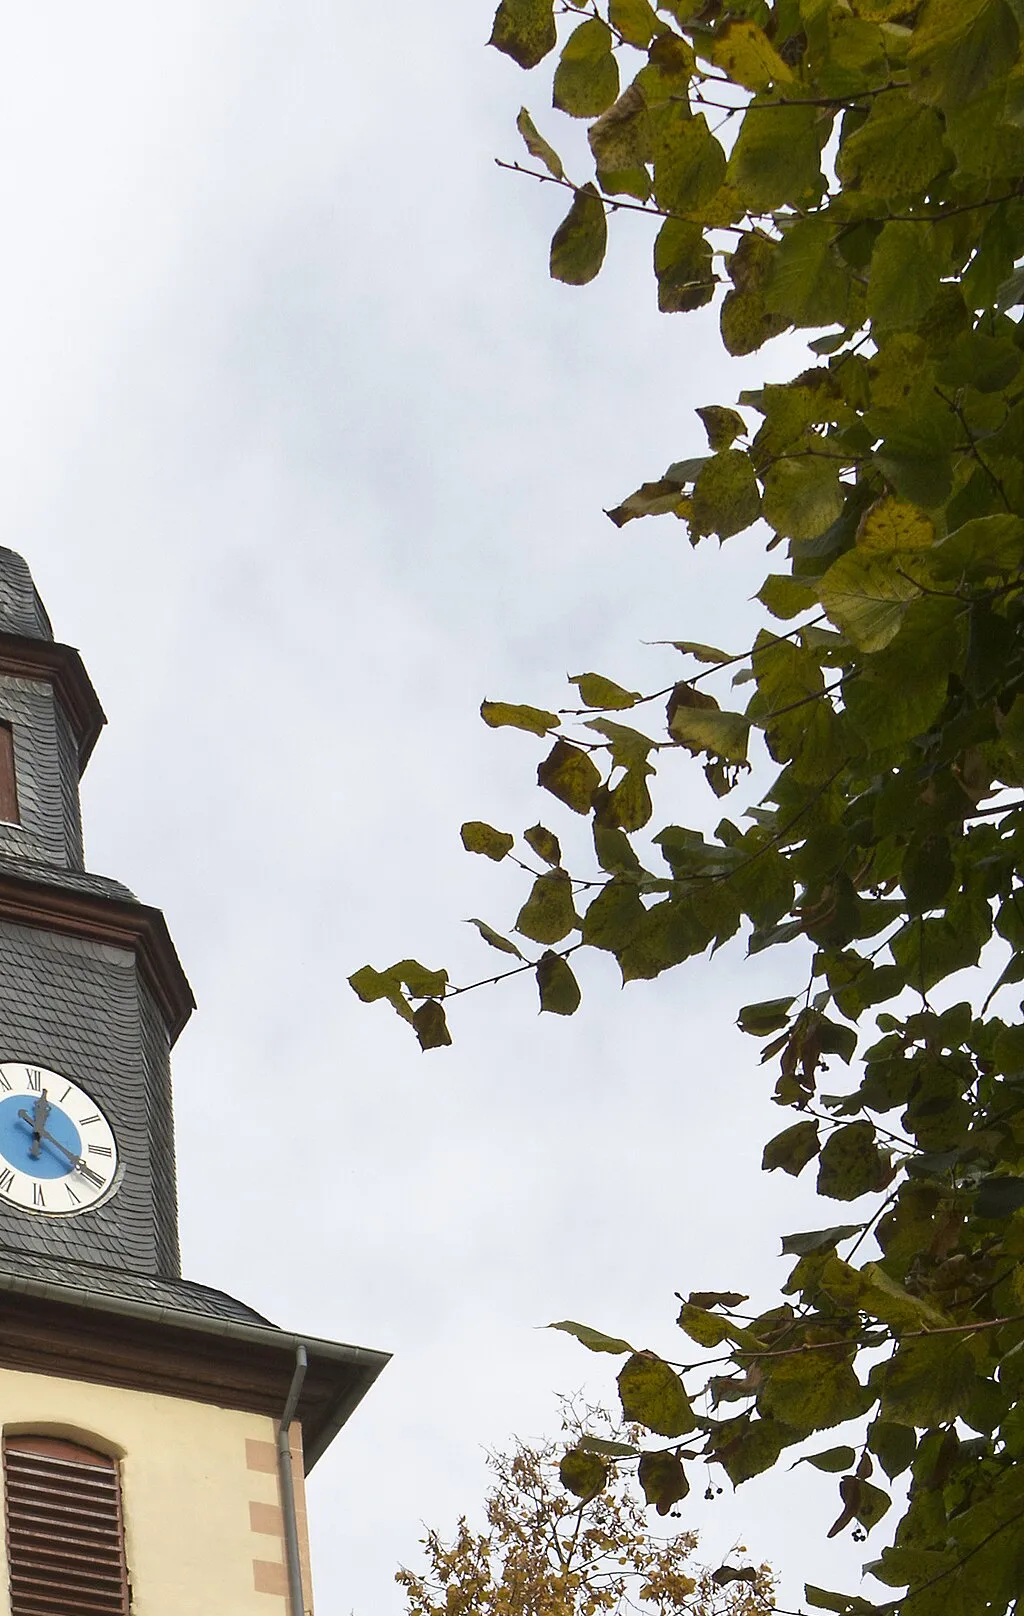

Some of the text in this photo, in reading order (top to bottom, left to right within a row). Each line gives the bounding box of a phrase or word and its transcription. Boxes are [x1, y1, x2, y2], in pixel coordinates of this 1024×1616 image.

[25, 1068, 41, 1091] XII
[59, 1086, 73, 1103] I
[78, 1114, 101, 1126] II
[88, 1144, 112, 1158] III
[32, 1182, 45, 1206] VI
[64, 1182, 82, 1206] V
